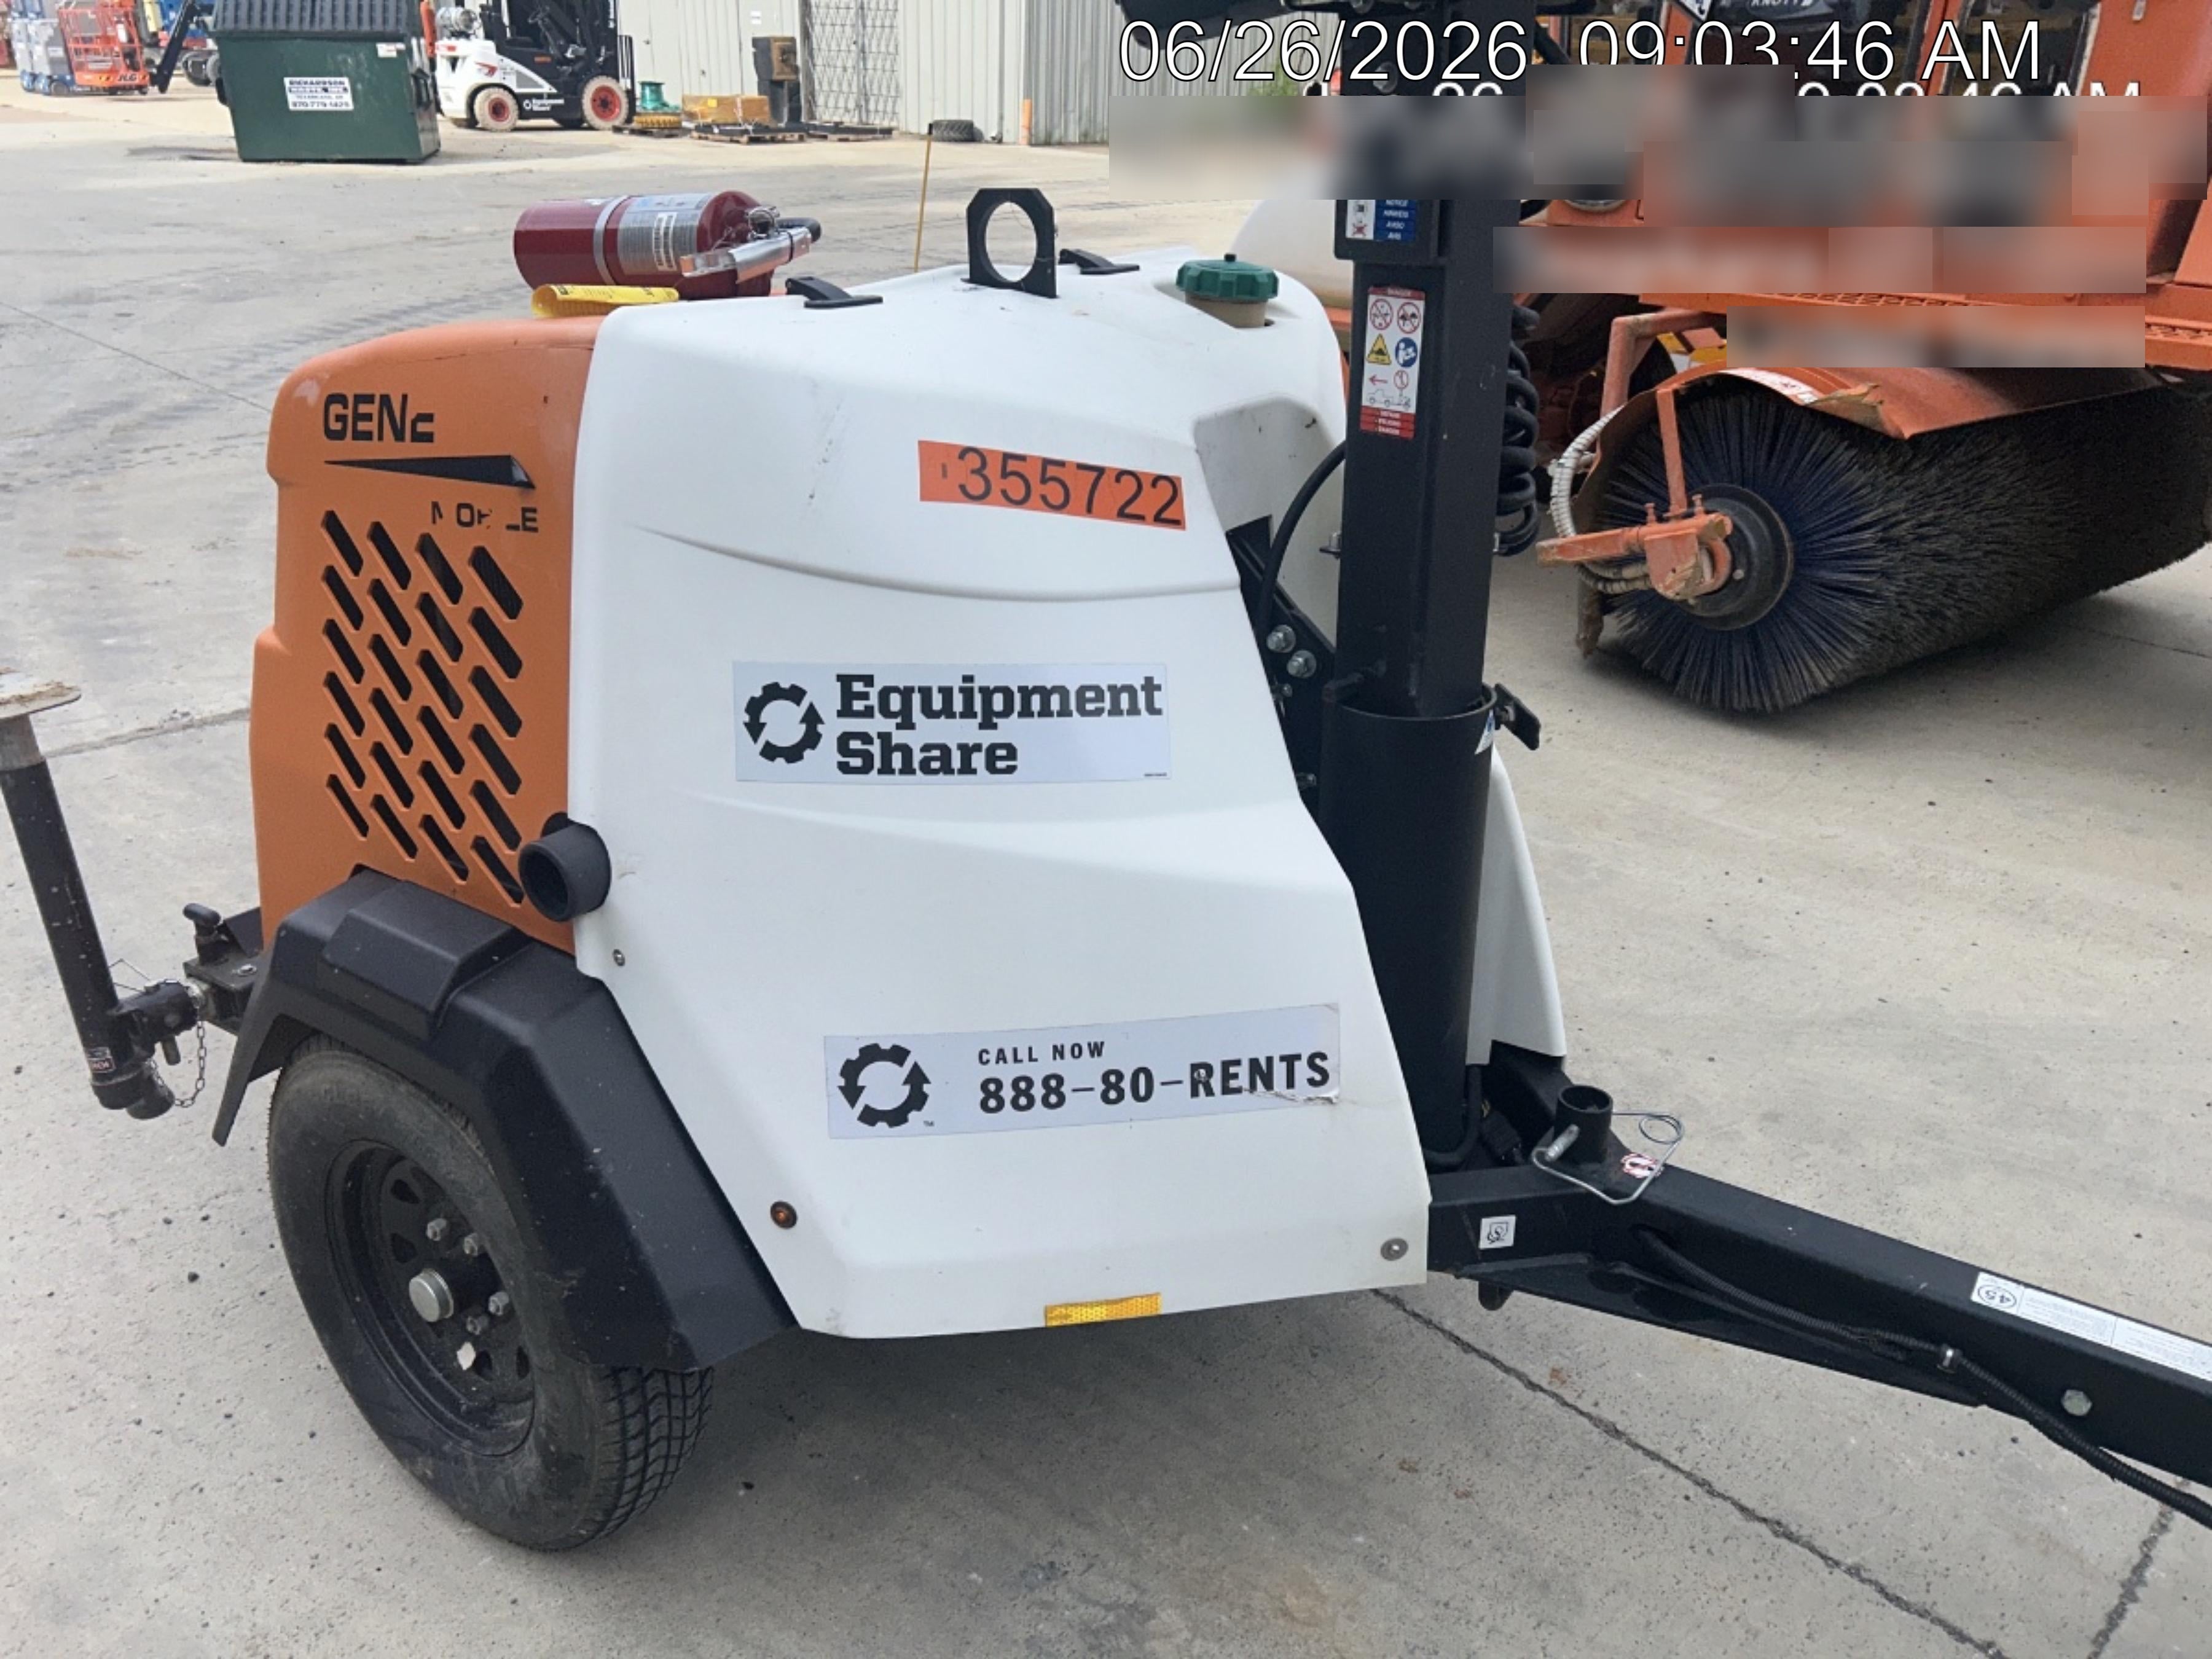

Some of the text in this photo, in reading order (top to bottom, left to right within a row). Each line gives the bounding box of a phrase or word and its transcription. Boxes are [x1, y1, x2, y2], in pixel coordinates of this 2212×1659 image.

[957, 446, 1182, 526] 355722
[836, 673, 1163, 731] Equipment
[836, 731, 1018, 775] Share
[978, 1040, 1107, 1066] CALL NOW
[979, 1051, 1331, 1114] 888-80-RENTS
